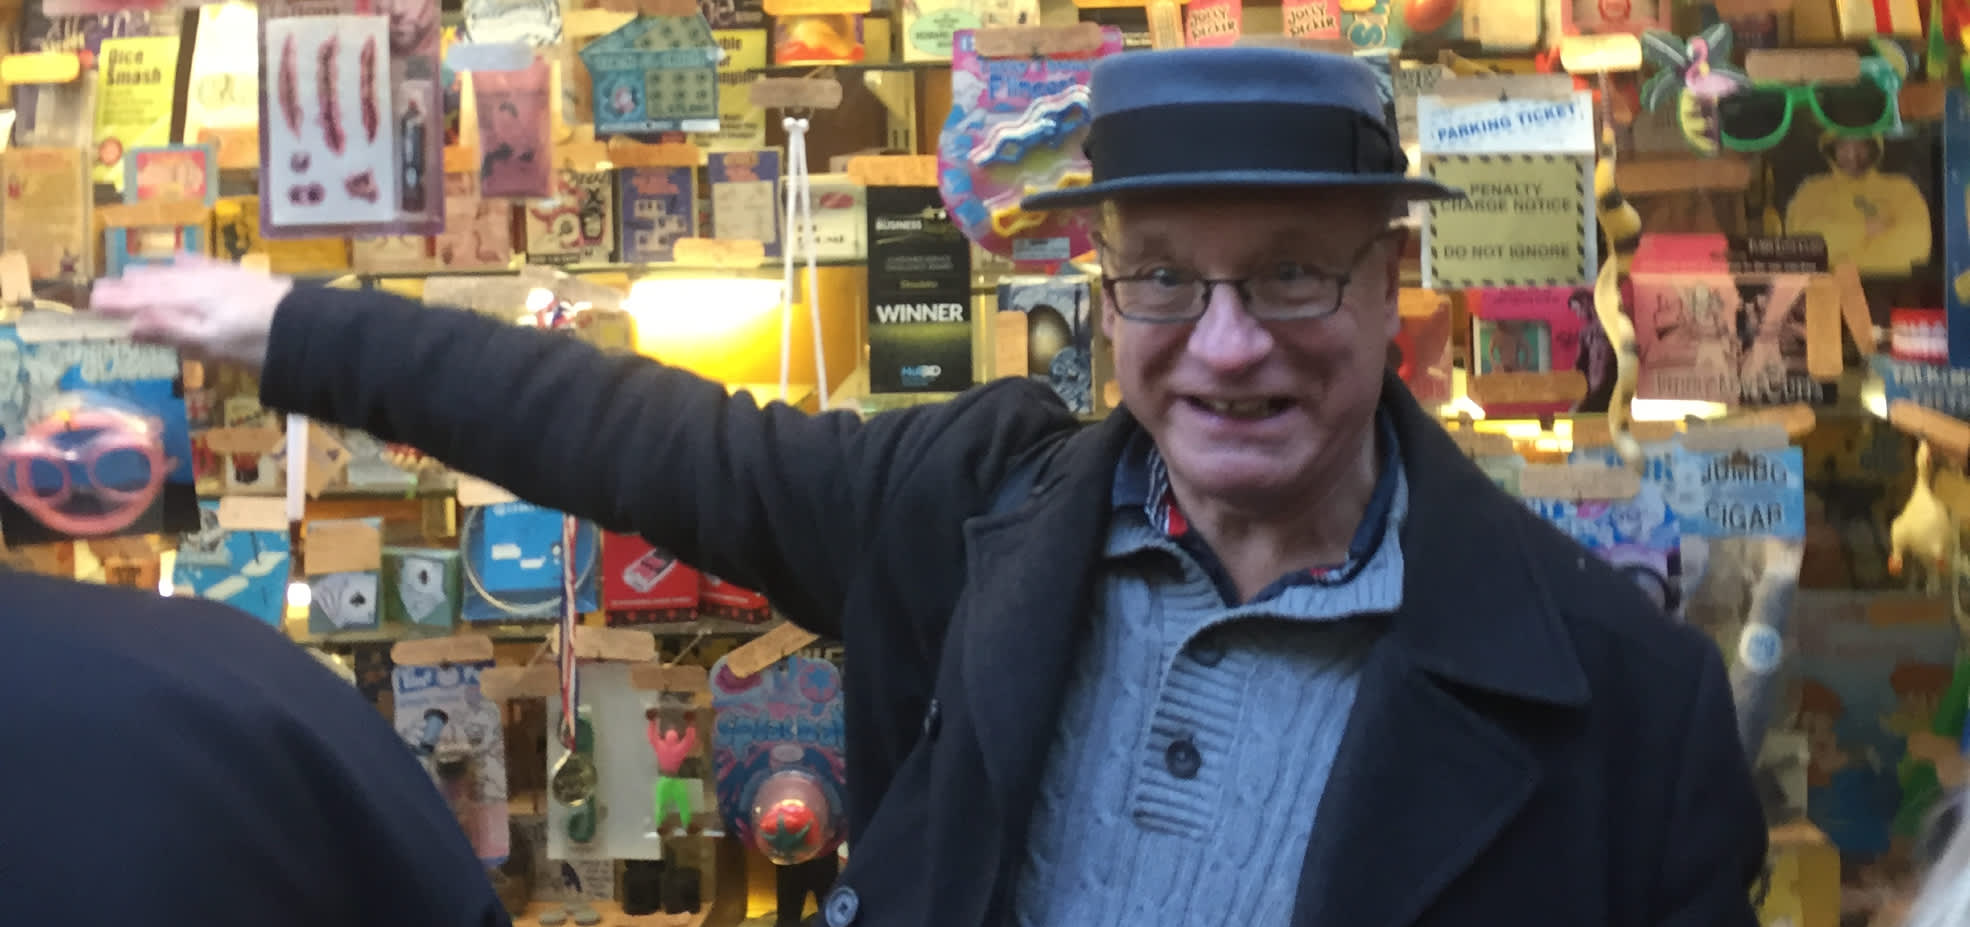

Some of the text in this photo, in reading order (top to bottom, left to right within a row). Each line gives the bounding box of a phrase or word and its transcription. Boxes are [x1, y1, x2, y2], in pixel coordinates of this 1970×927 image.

[1288, 4, 1327, 26] JOLLY
[108, 48, 144, 65] Dice
[106, 67, 161, 86] Smash
[1437, 103, 1576, 142] PARKING TICKET
[1469, 183, 1542, 196] PENALTY
[1439, 199, 1570, 213] CHARGE NOTICE
[875, 219, 922, 232] BUSINESS
[1443, 246, 1569, 257] DO NOT IGNORE
[876, 302, 964, 324] WINNER
[1700, 452, 1787, 485] JUMBO
[1704, 500, 1783, 532] CIGAR
